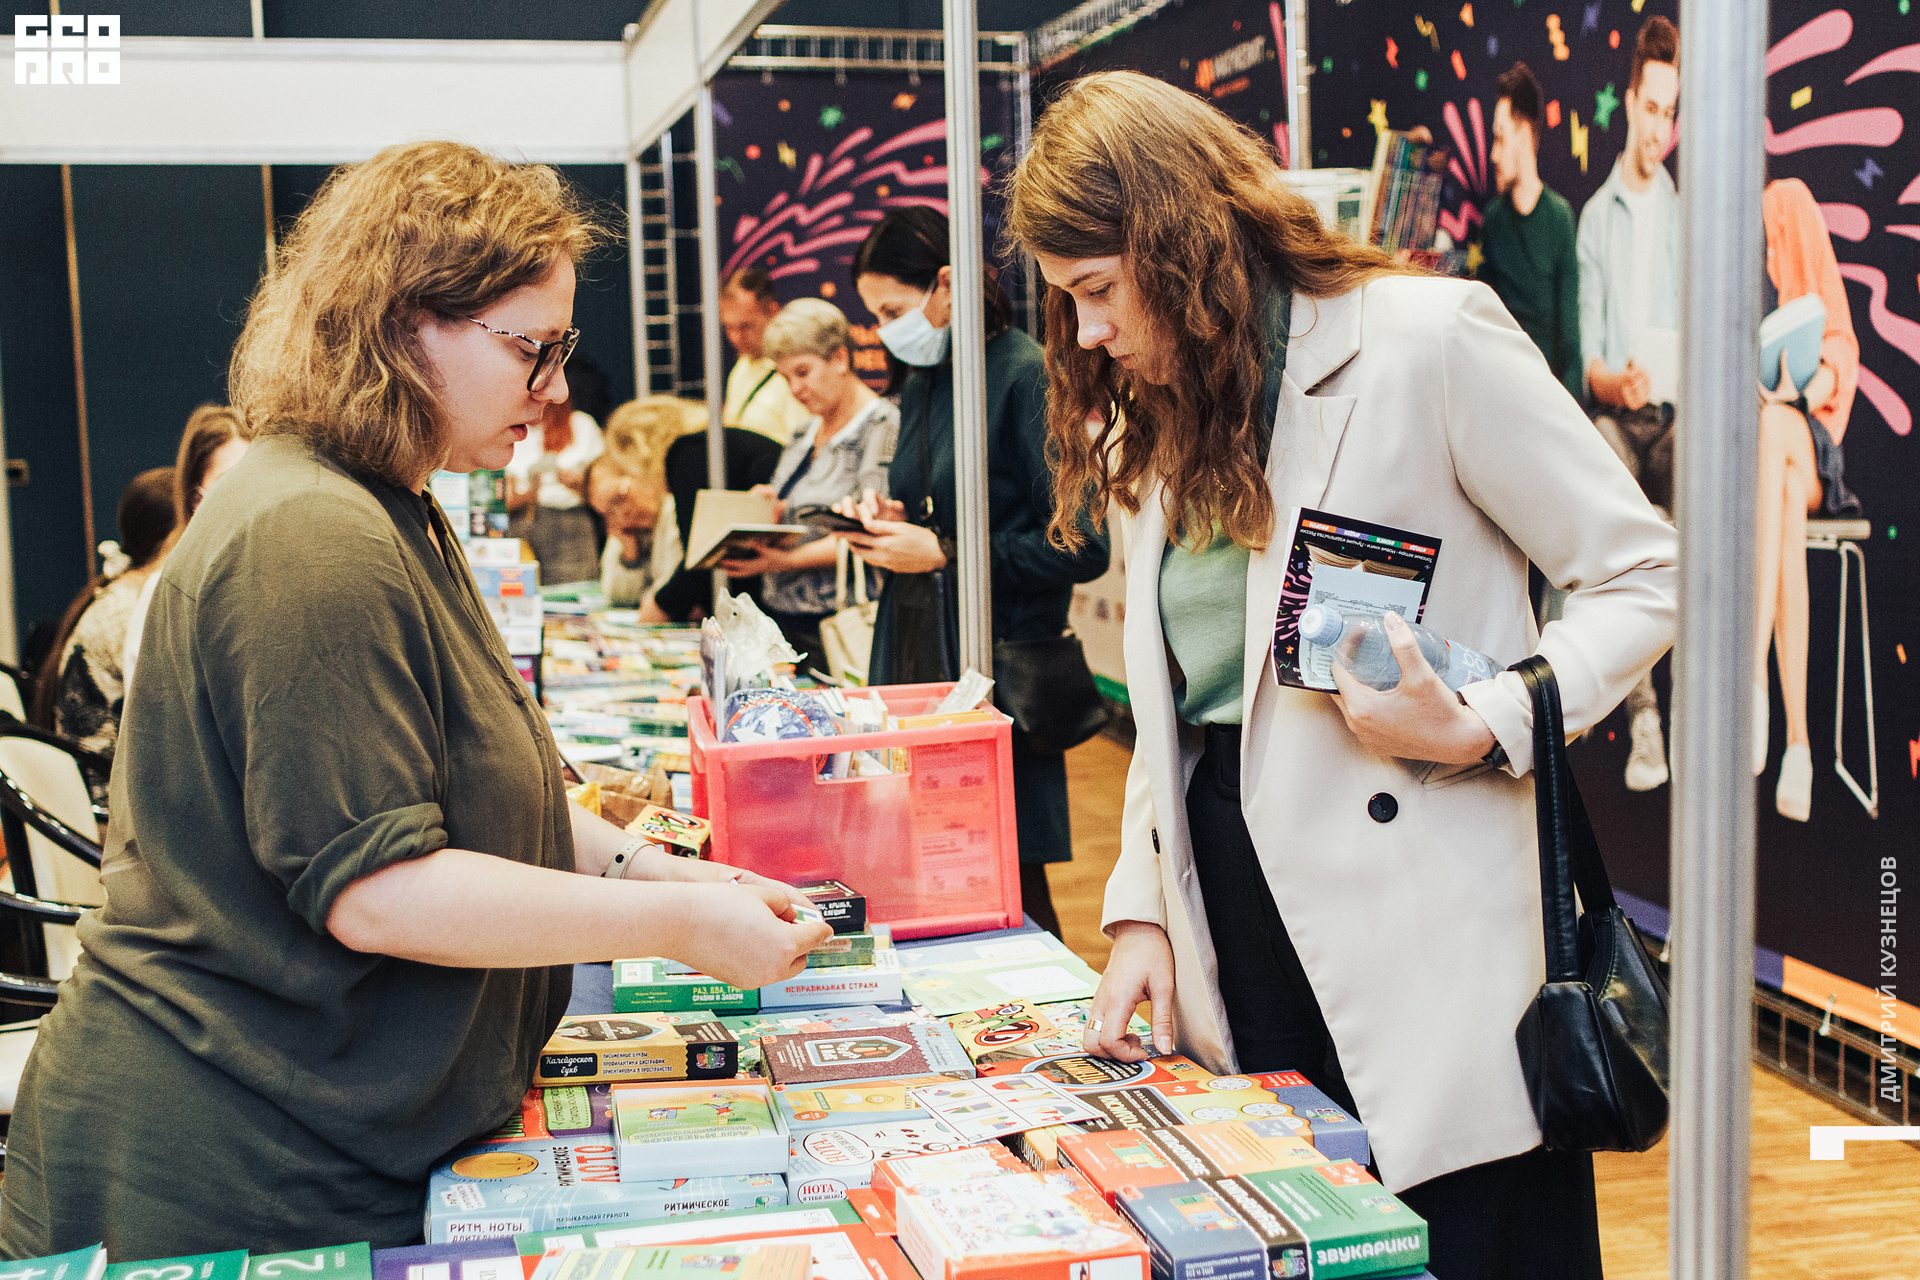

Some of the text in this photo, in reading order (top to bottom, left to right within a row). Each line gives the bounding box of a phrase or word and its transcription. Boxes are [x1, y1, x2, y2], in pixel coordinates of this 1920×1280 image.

[693, 987, 708, 995] РАЗ,
[785, 982, 879, 993] НЕПРАВИЛЬНАЯ СТРАНА
[546, 1056, 594, 1067] Калейдоскоп
[1152, 1128, 1211, 1177] ЗВУКАРИКИ
[552, 1145, 573, 1187] РИТМИЧЕСКОЕ
[573, 1144, 620, 1183] ЛОТО
[803, 1184, 837, 1195] НОТА,
[664, 1199, 730, 1211] РИТМИЧЕСКОЕ
[1216, 1178, 1288, 1238] ЗВУКАРИКИ
[556, 1212, 630, 1222] МУЗЫКАЛЬНАЯ ГРАМОТА
[450, 1222, 526, 1233] РИТМ, НОТЫ,
[1316, 1235, 1420, 1266] ЗВУКАРИКИ
